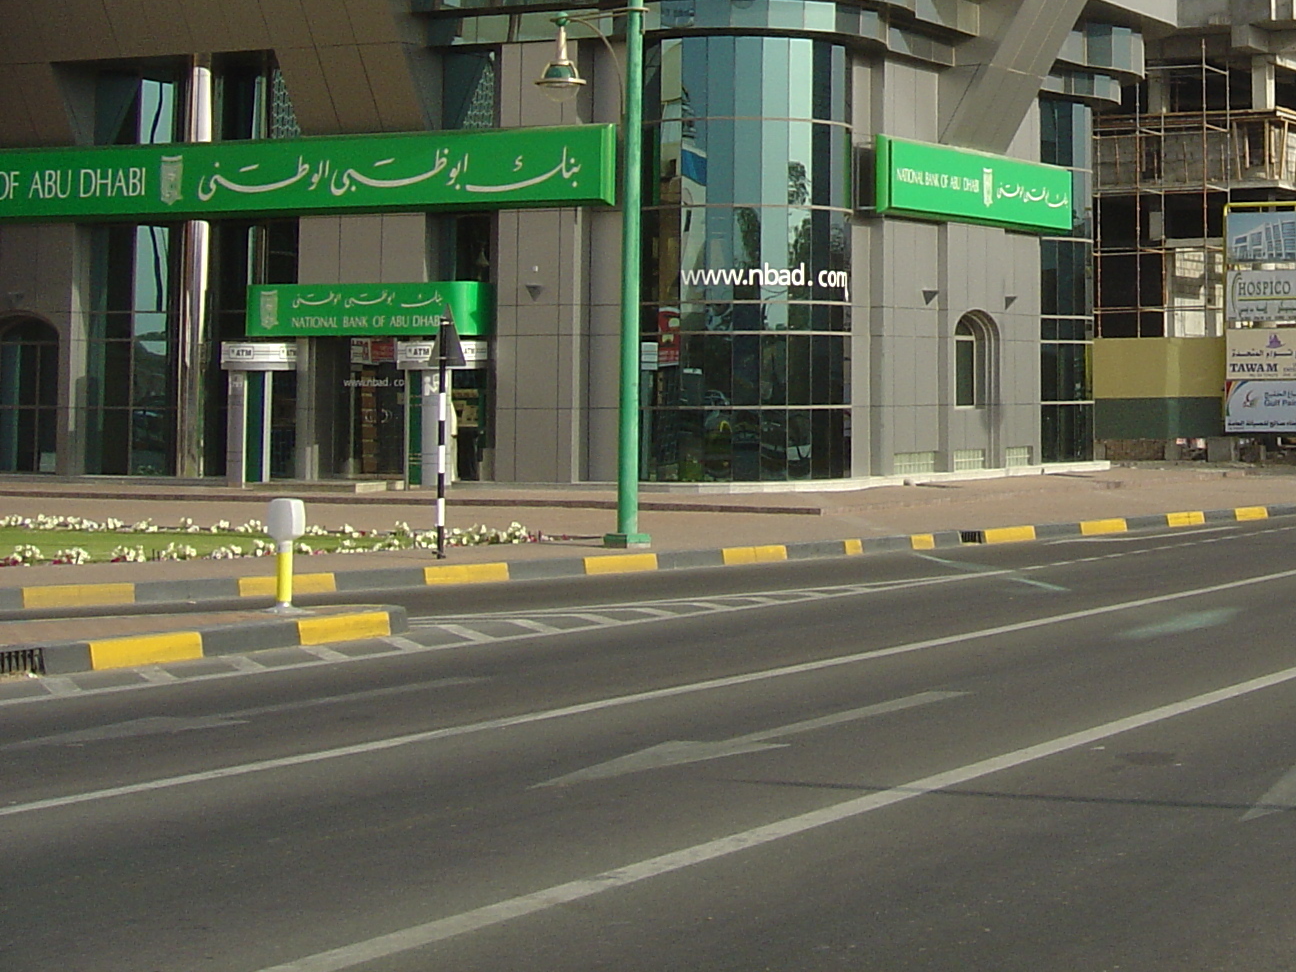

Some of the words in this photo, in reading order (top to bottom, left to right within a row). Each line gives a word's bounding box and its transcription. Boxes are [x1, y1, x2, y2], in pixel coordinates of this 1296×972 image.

[465, 146, 582, 192] بنك
[28, 169, 72, 199] ABU
[79, 167, 146, 198] DHABI
[896, 168, 924, 186] NATIONAL
[925, 171, 940, 188] BANK
[940, 174, 949, 189] OF
[950, 176, 961, 191] ABU
[963, 178, 980, 193] DHABI
[1238, 281, 1291, 296] HOSPICO
[400, 290, 443, 308] بنك
[291, 315, 338, 328] NATIONAL
[342, 315, 367, 328] BANK
[373, 315, 386, 327] OF
[389, 315, 410, 327] ABU
[412, 347, 430, 356] ATM
[1229, 362, 1278, 373] TAWAM
[1264, 399, 1280, 407] Gulf
